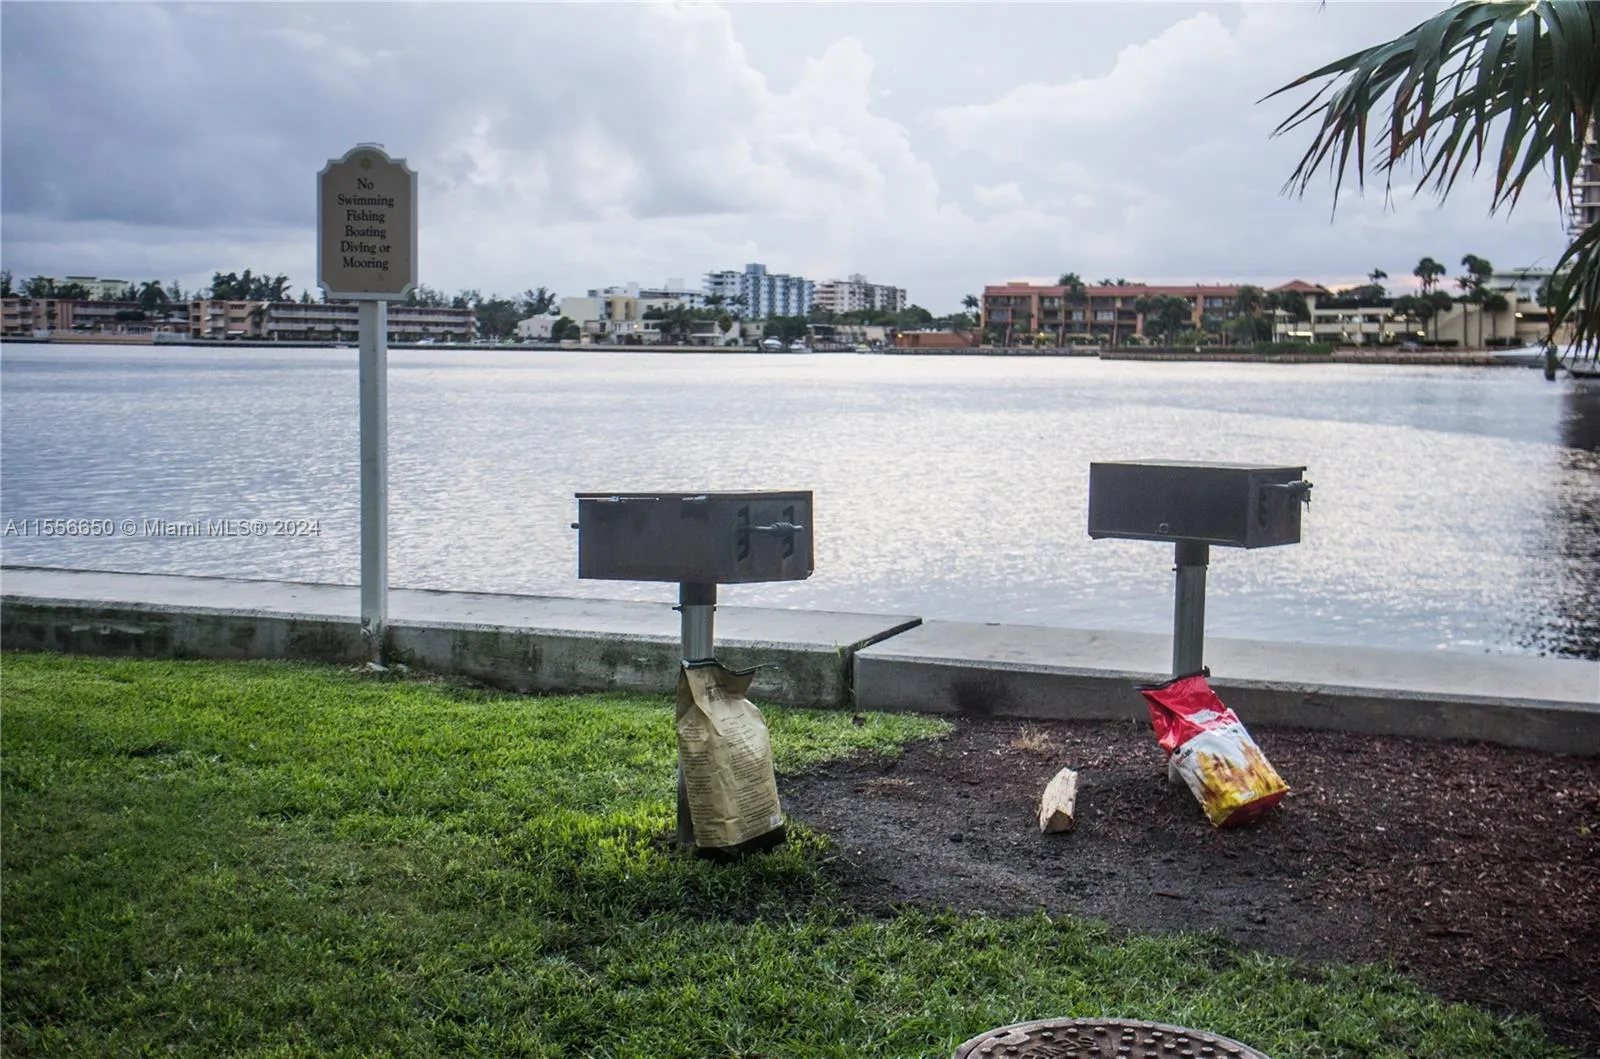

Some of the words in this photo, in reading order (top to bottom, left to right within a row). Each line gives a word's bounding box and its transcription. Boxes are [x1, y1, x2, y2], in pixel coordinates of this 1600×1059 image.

[356, 178, 375, 190] No
[337, 194, 394, 208] Swimming
[346, 209, 385, 223] Fishing
[345, 225, 386, 239] Boating
[340, 241, 377, 255] Diving
[379, 244, 391, 253] or
[342, 256, 389, 271] Mooring
